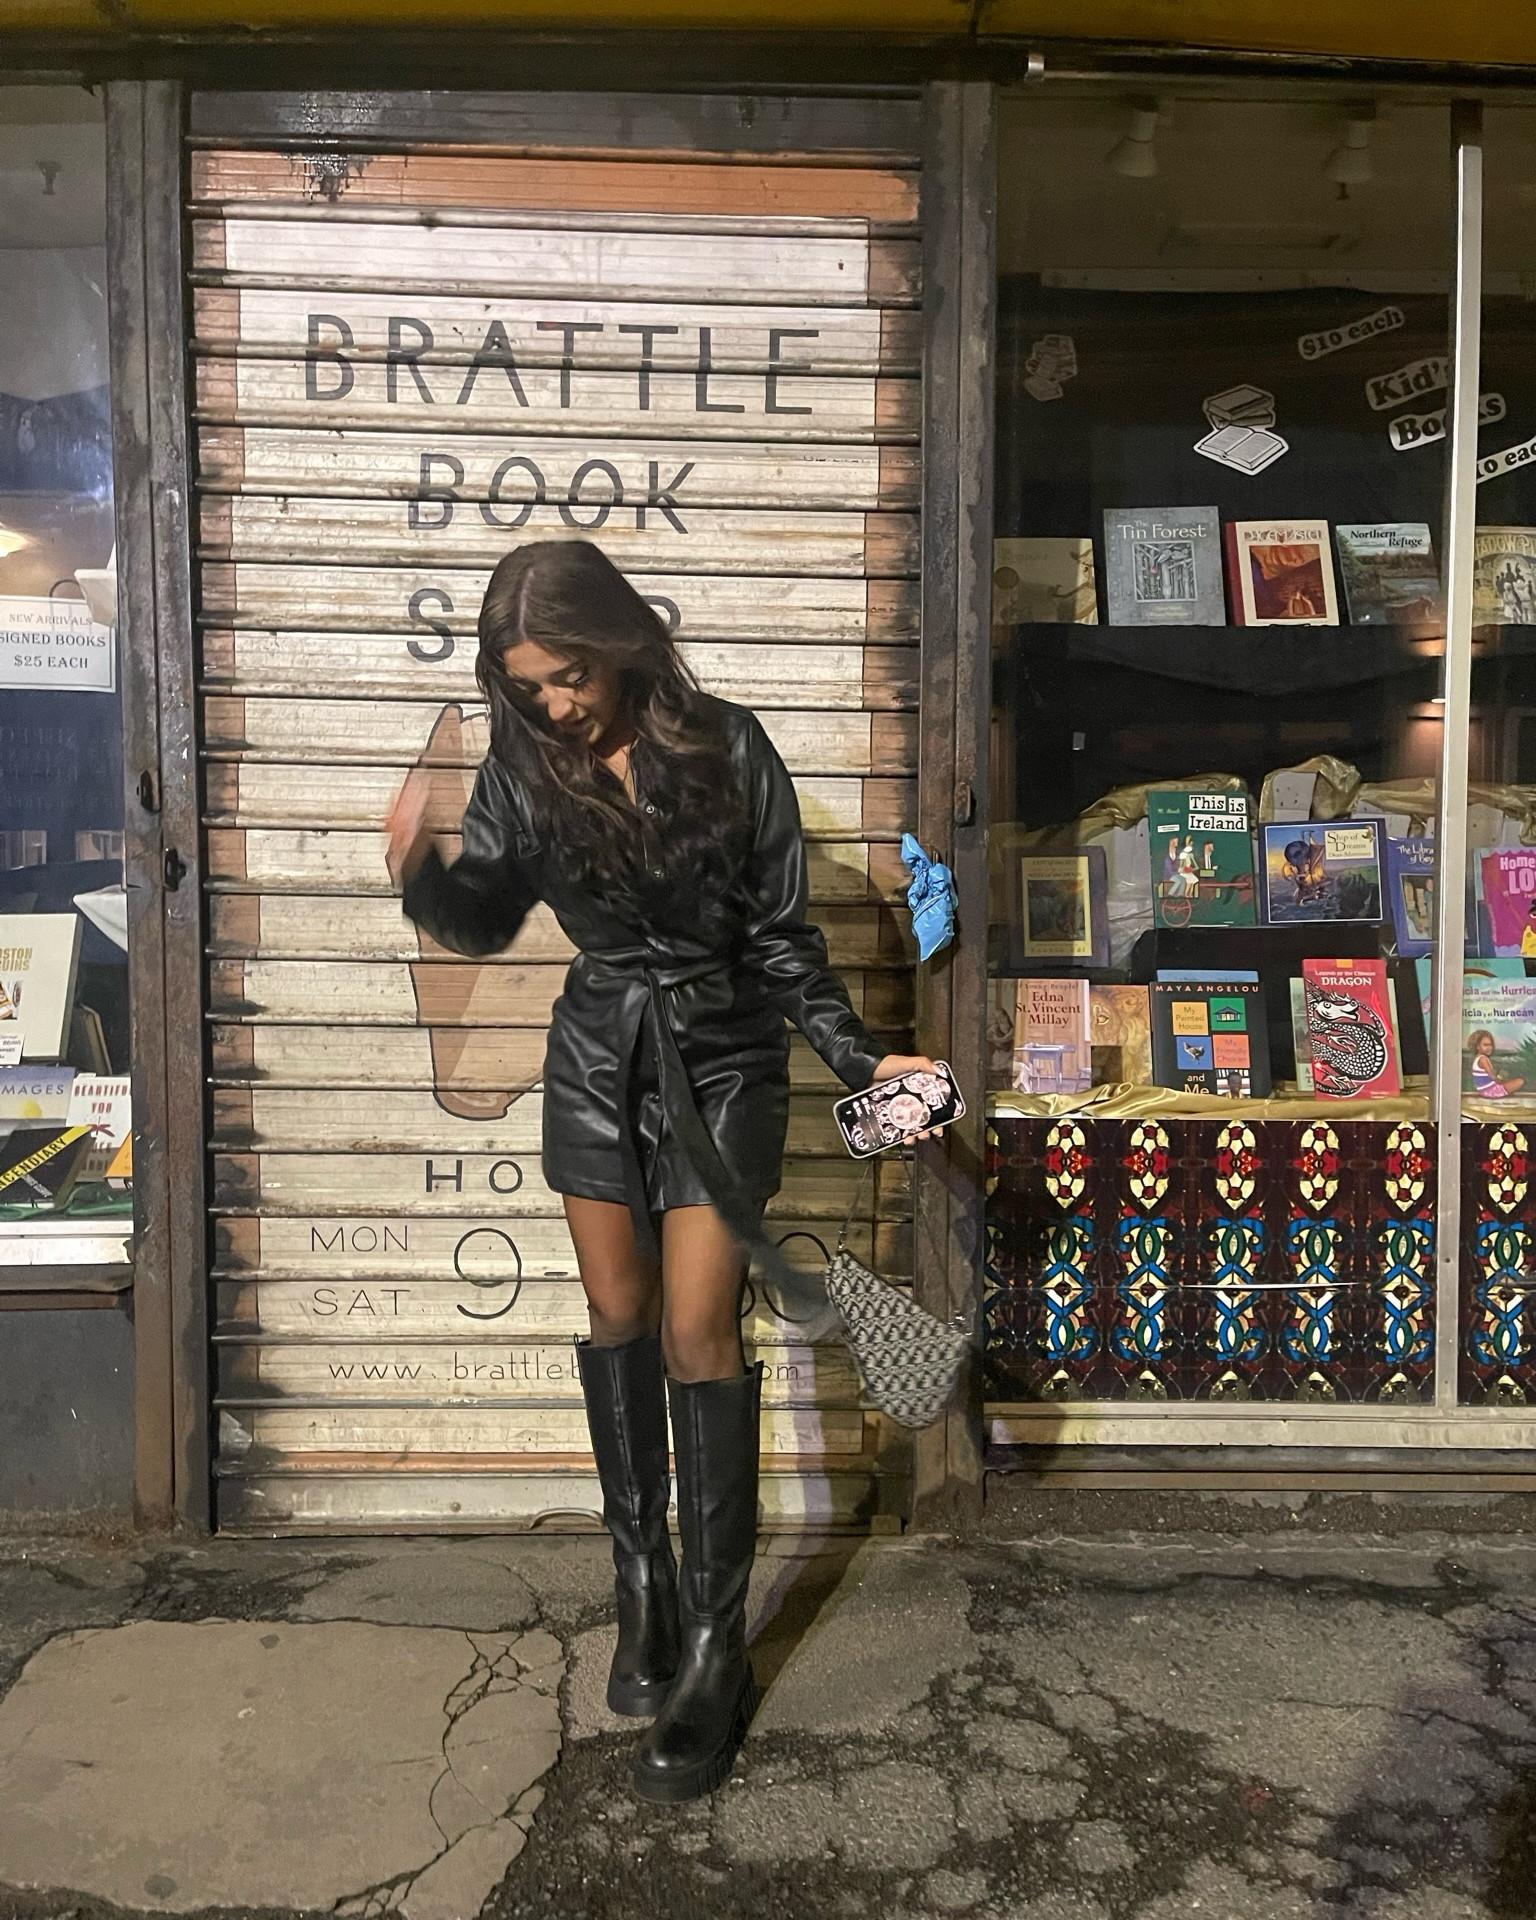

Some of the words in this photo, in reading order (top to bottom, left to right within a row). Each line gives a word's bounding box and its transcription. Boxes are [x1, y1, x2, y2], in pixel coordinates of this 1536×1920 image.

[1302, 332, 1343, 356] $10
[1349, 309, 1401, 339] each
[305, 314, 819, 414] BRATTLE
[1371, 361, 1450, 406] Kid'
[1395, 398, 1500, 446] Bos
[408, 453, 696, 534] BOOK
[1117, 524, 1146, 539] Tin
[1152, 524, 1207, 538] Forest
[1351, 529, 1396, 540] Northern
[1389, 536, 1422, 548] Refuge
[9, 613, 34, 623] NEW
[36, 614, 93, 626] ARRIVALS
[56, 634, 106, 647] BOOKS
[14, 655, 42, 667] $25
[47, 656, 88, 669] EACH
[1191, 796, 1224, 809] This
[1230, 800, 1244, 812] is
[1190, 816, 1245, 830] Ireland
[1500, 856, 1536, 871] Home
[1508, 868, 1536, 894] LO
[0, 947, 33, 960] STON
[0, 959, 30, 971] UINS
[1321, 977, 1372, 987] DRAGON
[1155, 985, 1191, 993] MAYA
[1197, 985, 1259, 993] ANGELOU
[1032, 992, 1064, 1002] Edna
[1016, 1003, 1030, 1013] St.
[1032, 1002, 1081, 1013] Vincent
[1184, 1006, 1195, 1015] My
[1028, 1014, 1069, 1028] Millay
[1187, 1073, 1205, 1082] and
[2, 1084, 64, 1095] MAGES
[74, 1084, 130, 1097] BEAUTIFU
[1184, 1083, 1210, 1095] Me
[92, 1102, 112, 1114] YOU
[0, 1138, 66, 1190] NCENDIARY
[426, 1160, 523, 1194] HO
[311, 1225, 408, 1252] MON
[313, 1289, 410, 1317] SAT
